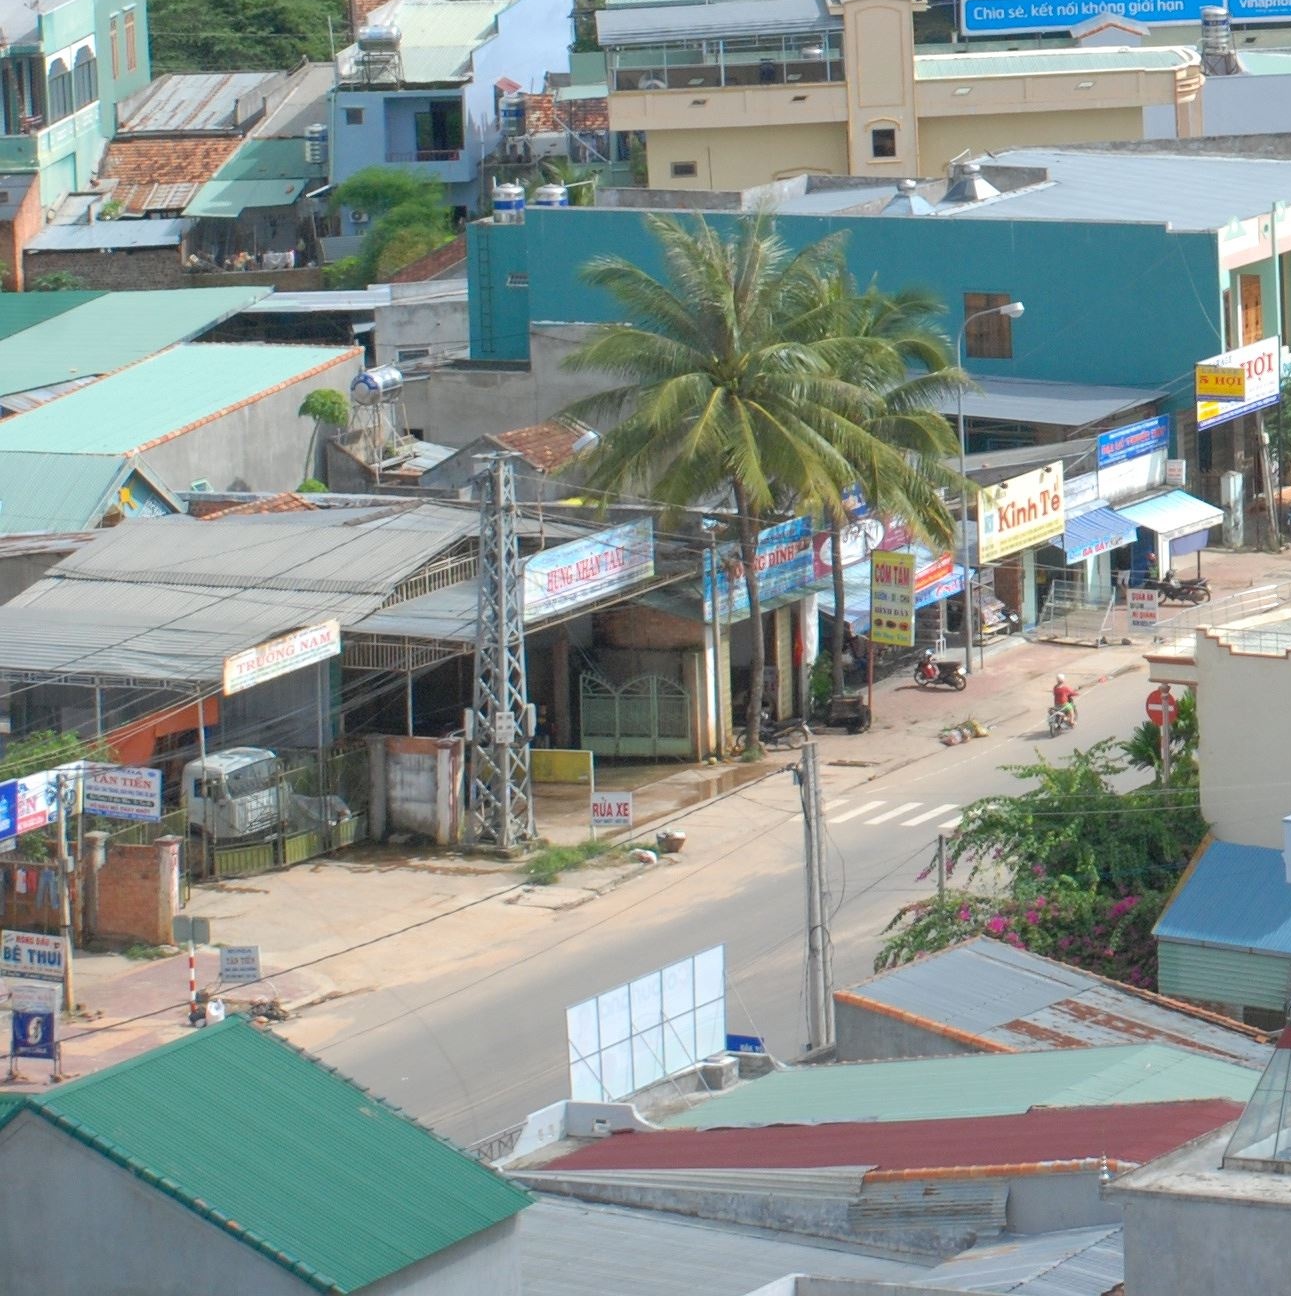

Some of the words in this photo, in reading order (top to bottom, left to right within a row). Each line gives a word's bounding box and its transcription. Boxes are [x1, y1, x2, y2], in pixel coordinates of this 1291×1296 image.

[974, 7, 1004, 21] Chia
[1031, 1, 1054, 17] kết
[1240, 351, 1274, 381] HỢI
[998, 496, 1038, 533] Kinh
[300, 631, 332, 651] NAM
[616, 802, 630, 817] XE
[3, 944, 21, 962] BÊ
